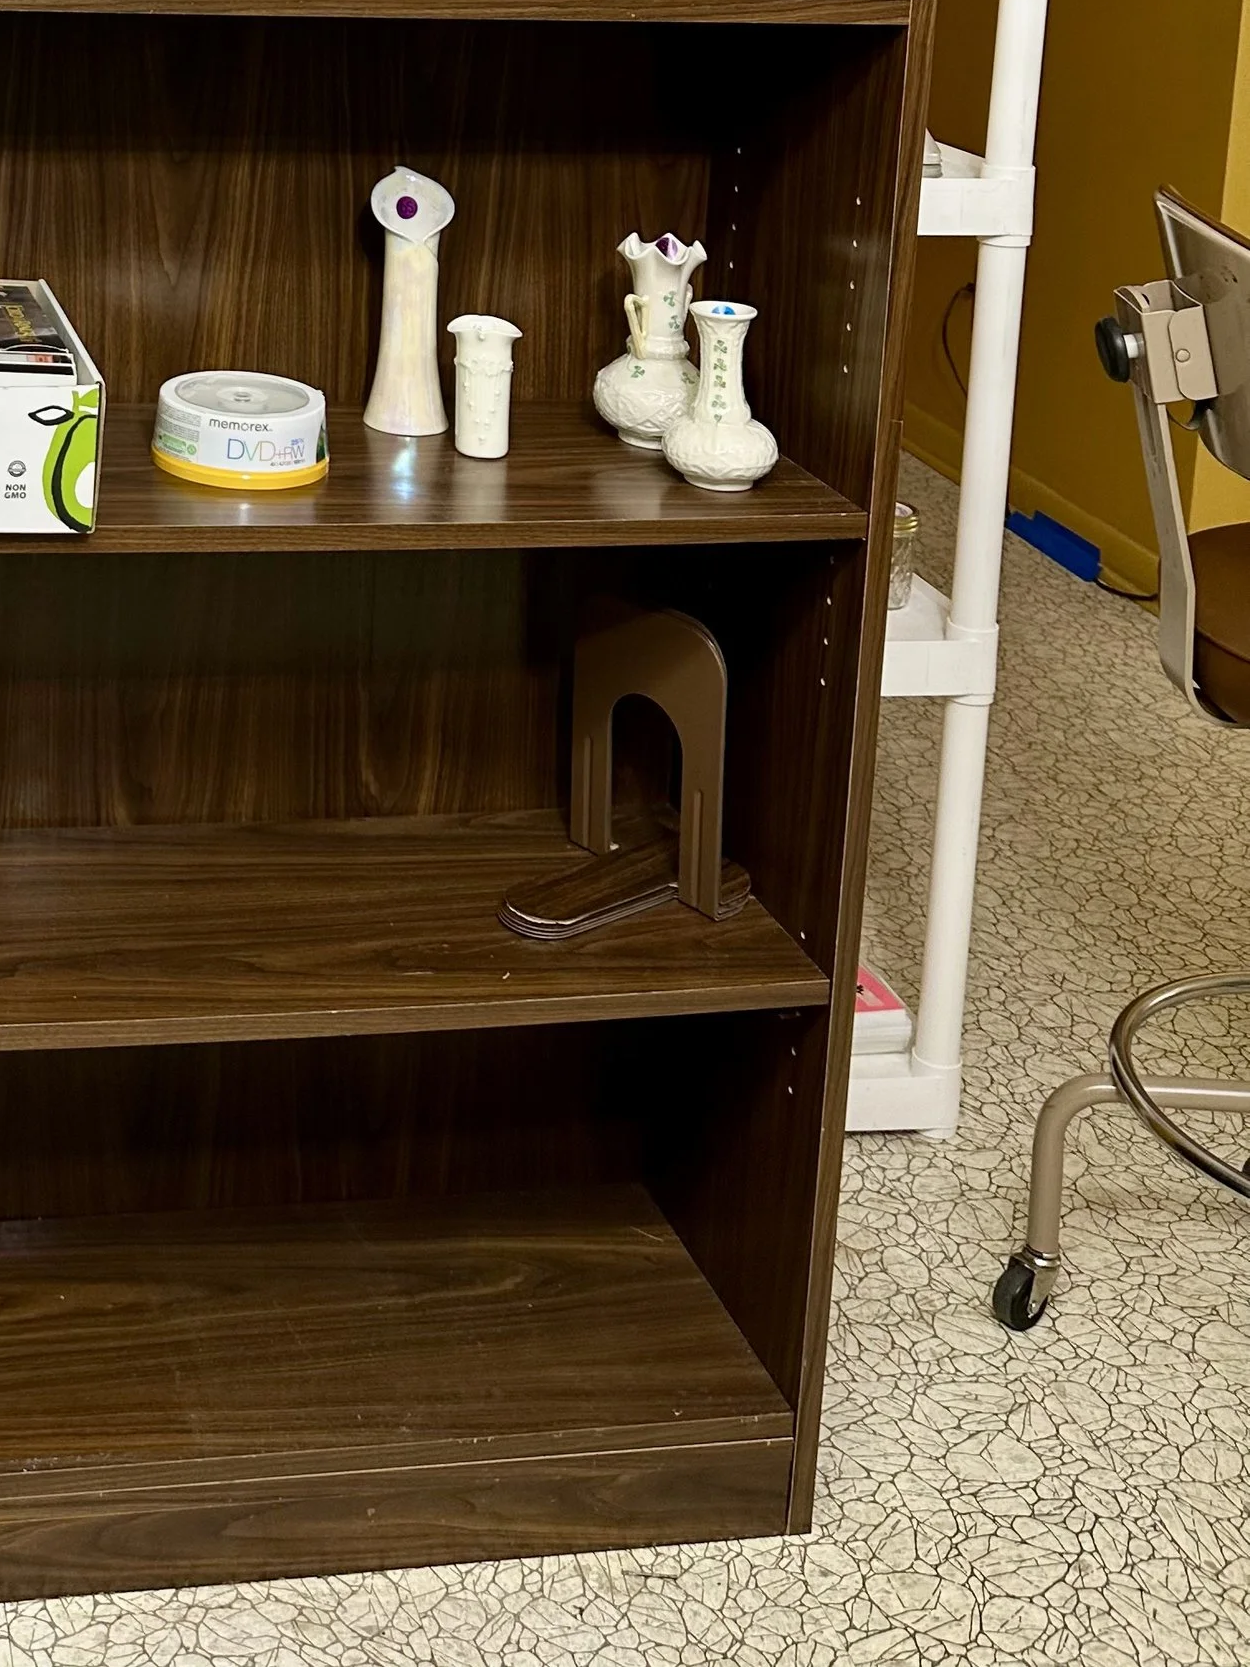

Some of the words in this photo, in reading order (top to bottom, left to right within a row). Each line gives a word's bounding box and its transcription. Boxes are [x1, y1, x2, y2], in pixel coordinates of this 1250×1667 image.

[209, 418, 269, 432] memorex
[227, 438, 305, 462] DVD+RW
[4, 491, 27, 499] GMO
